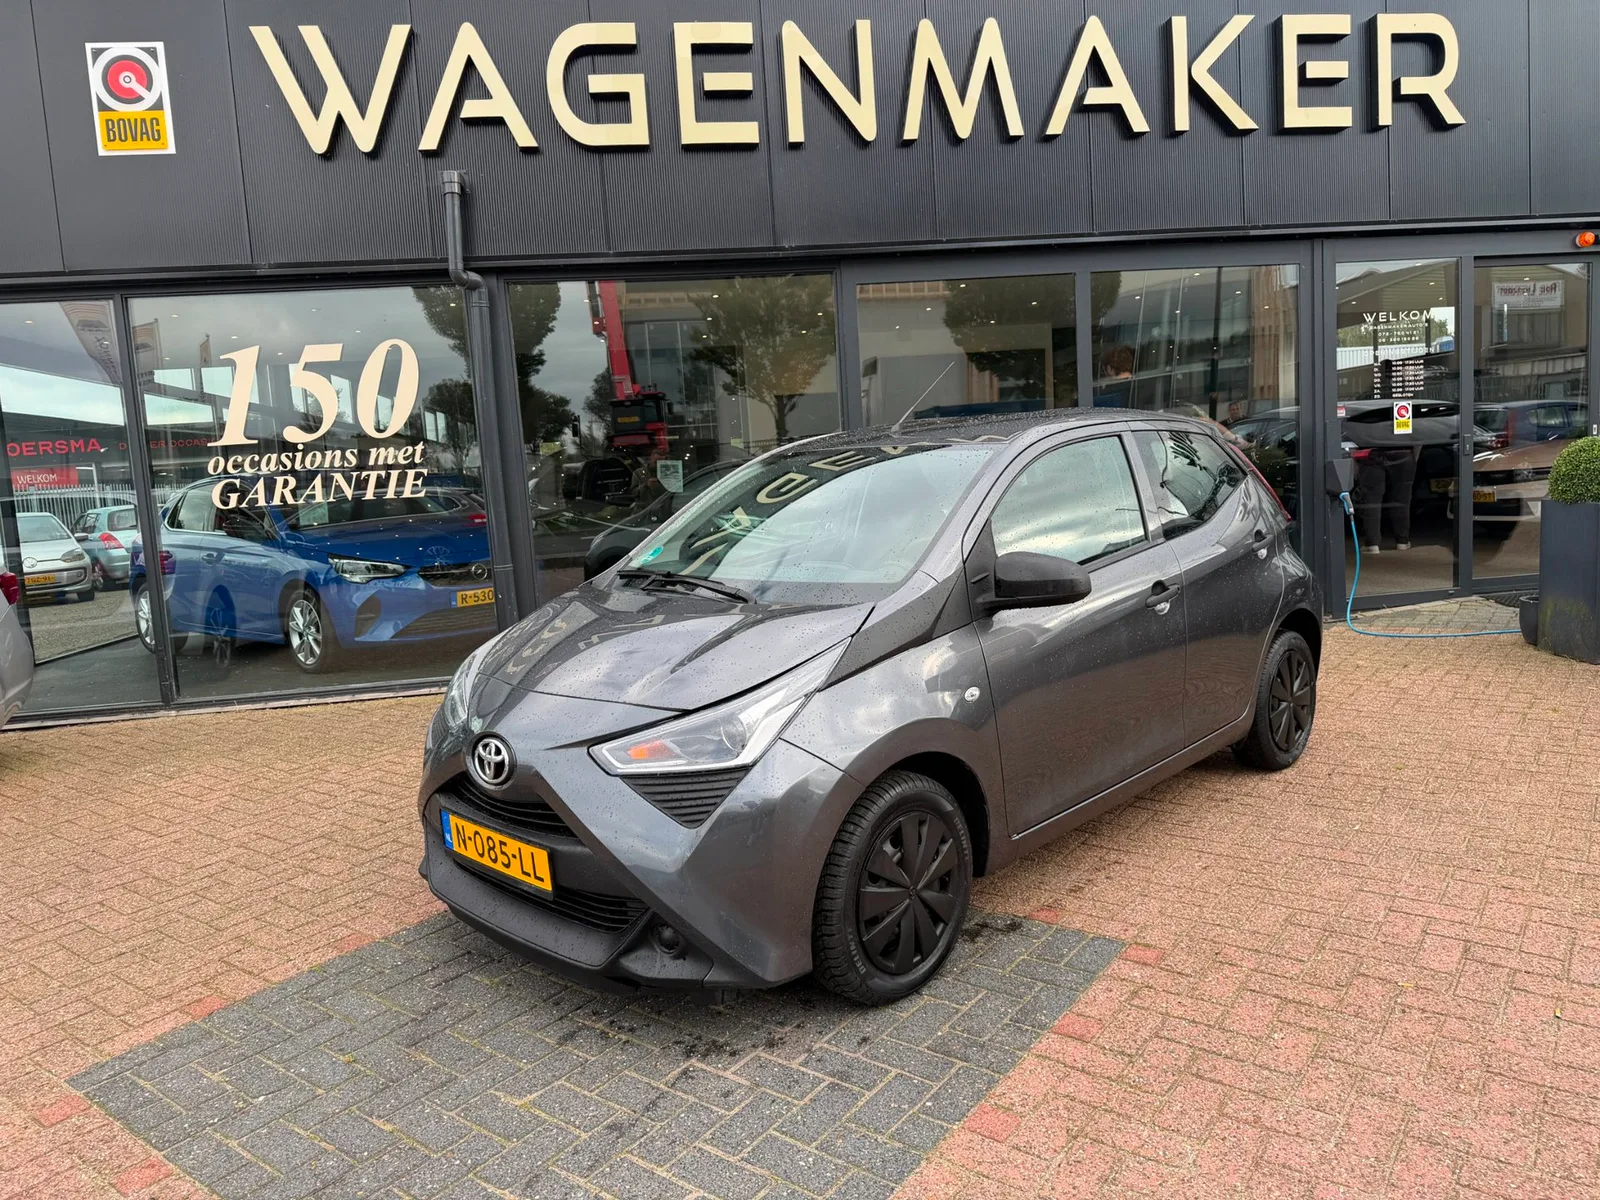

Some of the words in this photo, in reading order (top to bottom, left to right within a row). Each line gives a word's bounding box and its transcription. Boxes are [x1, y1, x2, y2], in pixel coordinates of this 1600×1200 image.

[249, 13, 1467, 155] WAGENMAKER
[104, 117, 162, 143] BOVAG
[1362, 310, 1434, 323] WELKOM
[207, 338, 420, 447] 150
[207, 443, 358, 476] occasions
[368, 441, 425, 466] met
[17, 473, 58, 484] WELKOM
[211, 468, 428, 510] GARANTIE
[460, 589, 494, 605] R-530
[455, 822, 545, 883] N-085-LL
